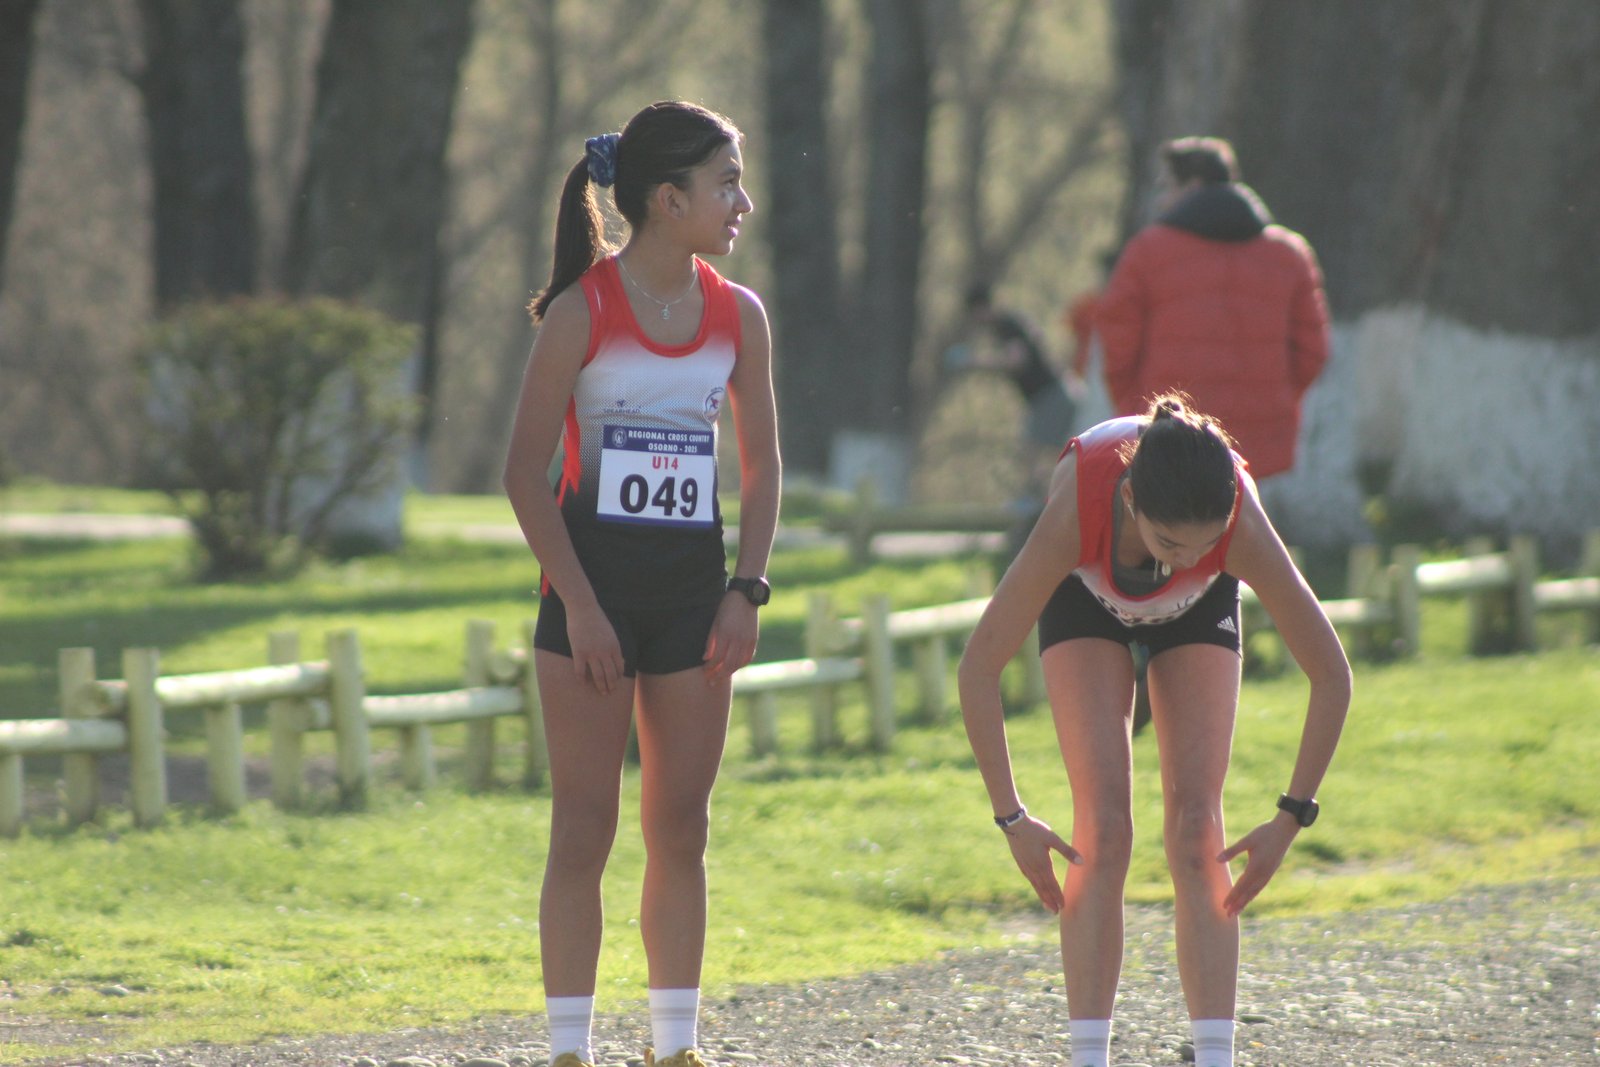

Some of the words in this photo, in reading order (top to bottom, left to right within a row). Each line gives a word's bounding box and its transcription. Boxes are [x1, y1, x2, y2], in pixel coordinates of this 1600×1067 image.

[628, 430, 666, 441] REGIONAL
[667, 433, 688, 442] CROSS
[689, 434, 710, 443] COUNTRY
[648, 443, 678, 452] OSORNO
[684, 445, 698, 453] 2025
[652, 456, 678, 470] U14
[620, 474, 698, 517] 049
